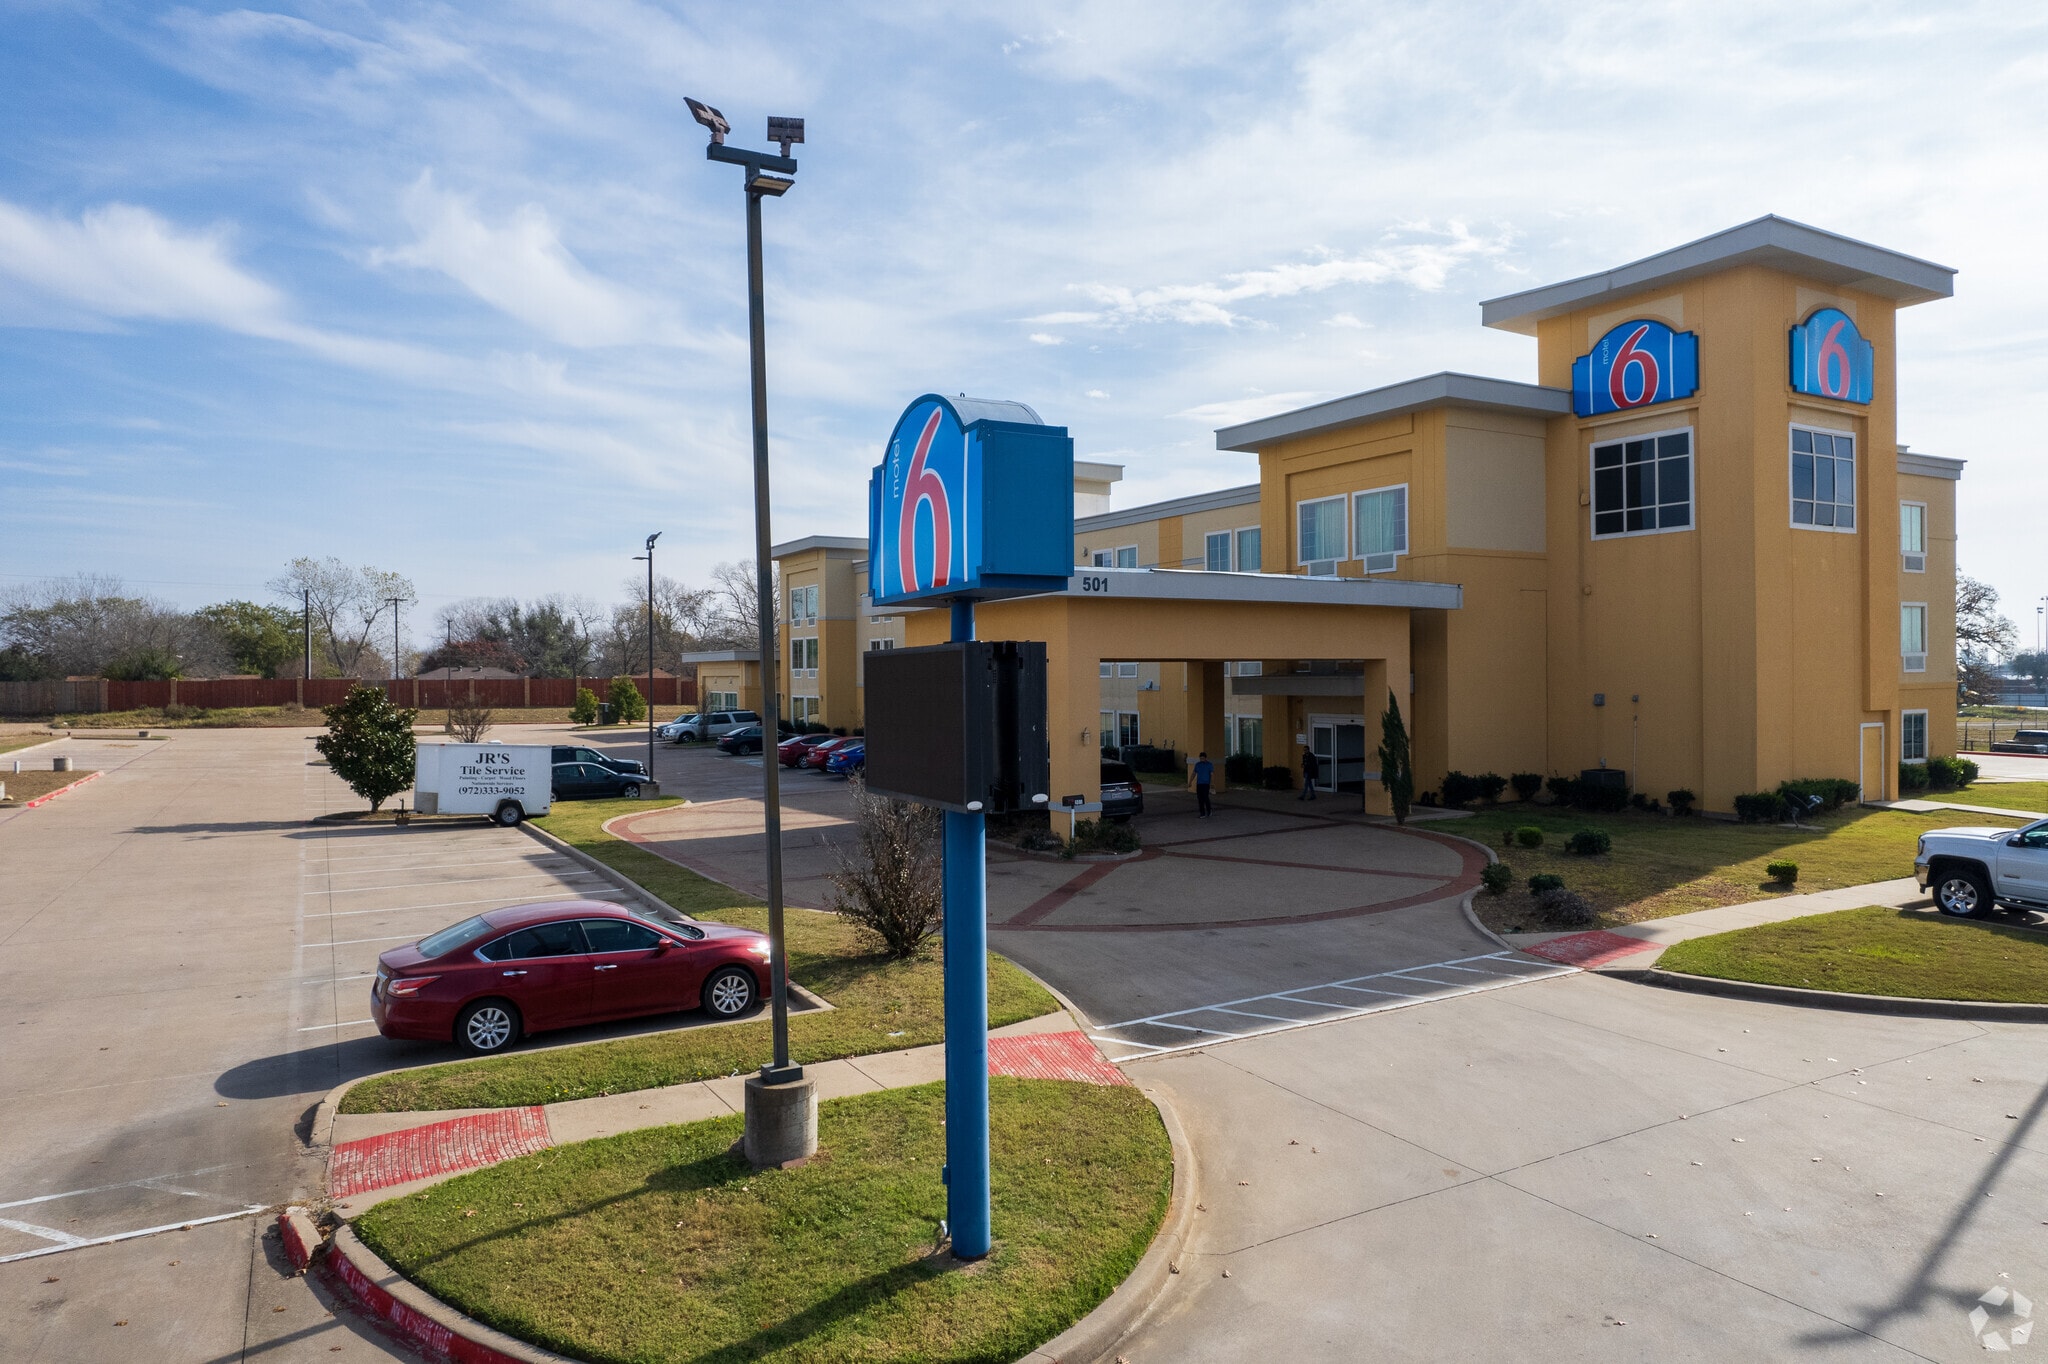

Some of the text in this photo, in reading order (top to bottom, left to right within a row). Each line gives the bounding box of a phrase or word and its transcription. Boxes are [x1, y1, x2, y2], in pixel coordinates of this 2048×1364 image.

[1608, 324, 1660, 408] 6
[1818, 319, 1851, 398] 6
[898, 405, 952, 593] 6
[1082, 577, 1108, 592] 501
[475, 752, 510, 764] JR'S
[460, 766, 525, 775] Tile Service
[458, 787, 525, 795] (972)333-9052
